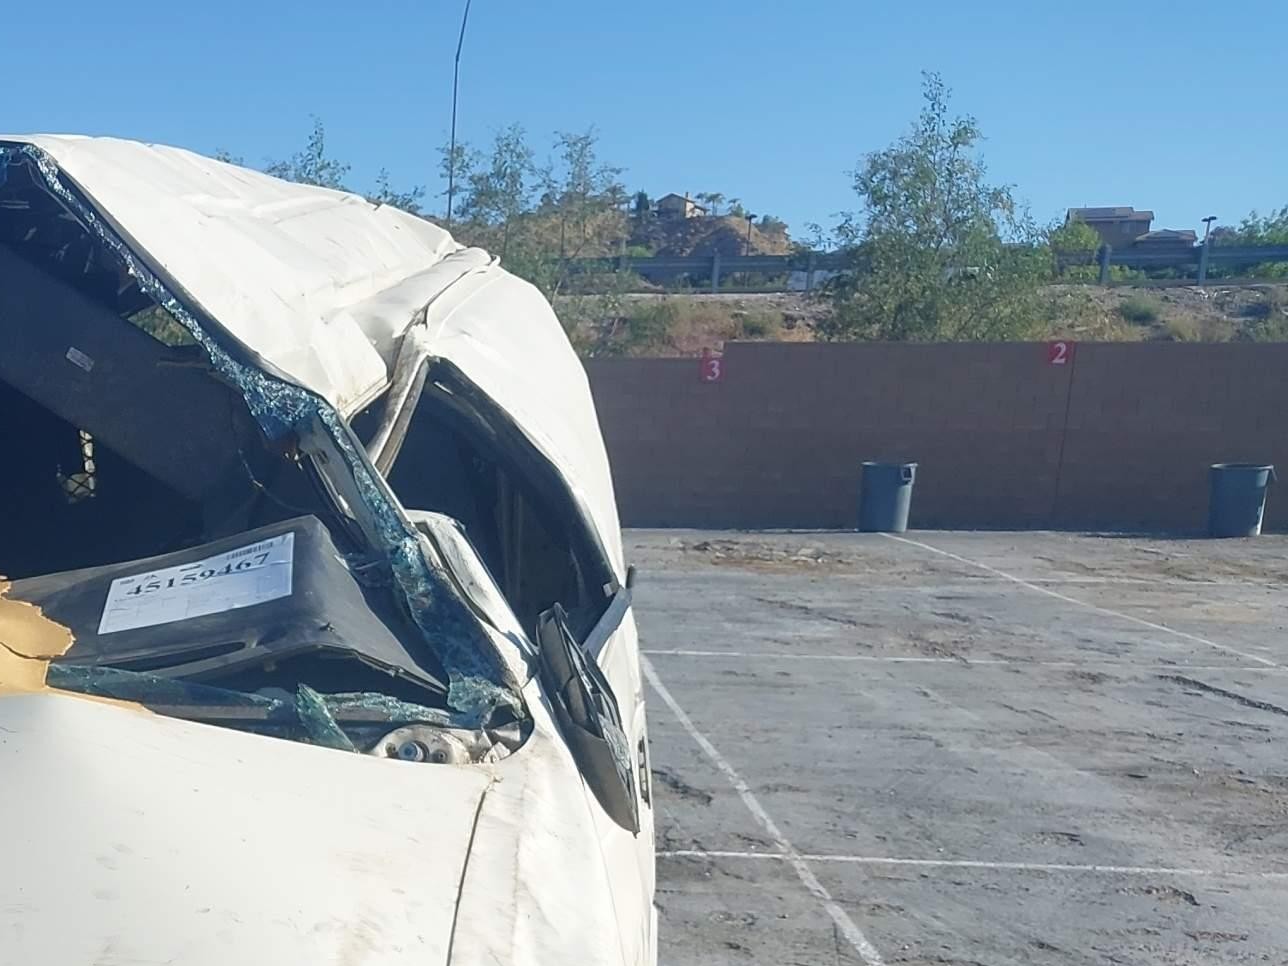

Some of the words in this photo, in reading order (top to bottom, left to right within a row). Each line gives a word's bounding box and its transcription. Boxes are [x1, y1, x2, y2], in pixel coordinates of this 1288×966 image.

[1052, 342, 1066, 363] 2
[707, 360, 720, 380] 3
[126, 552, 270, 595] 45159467
